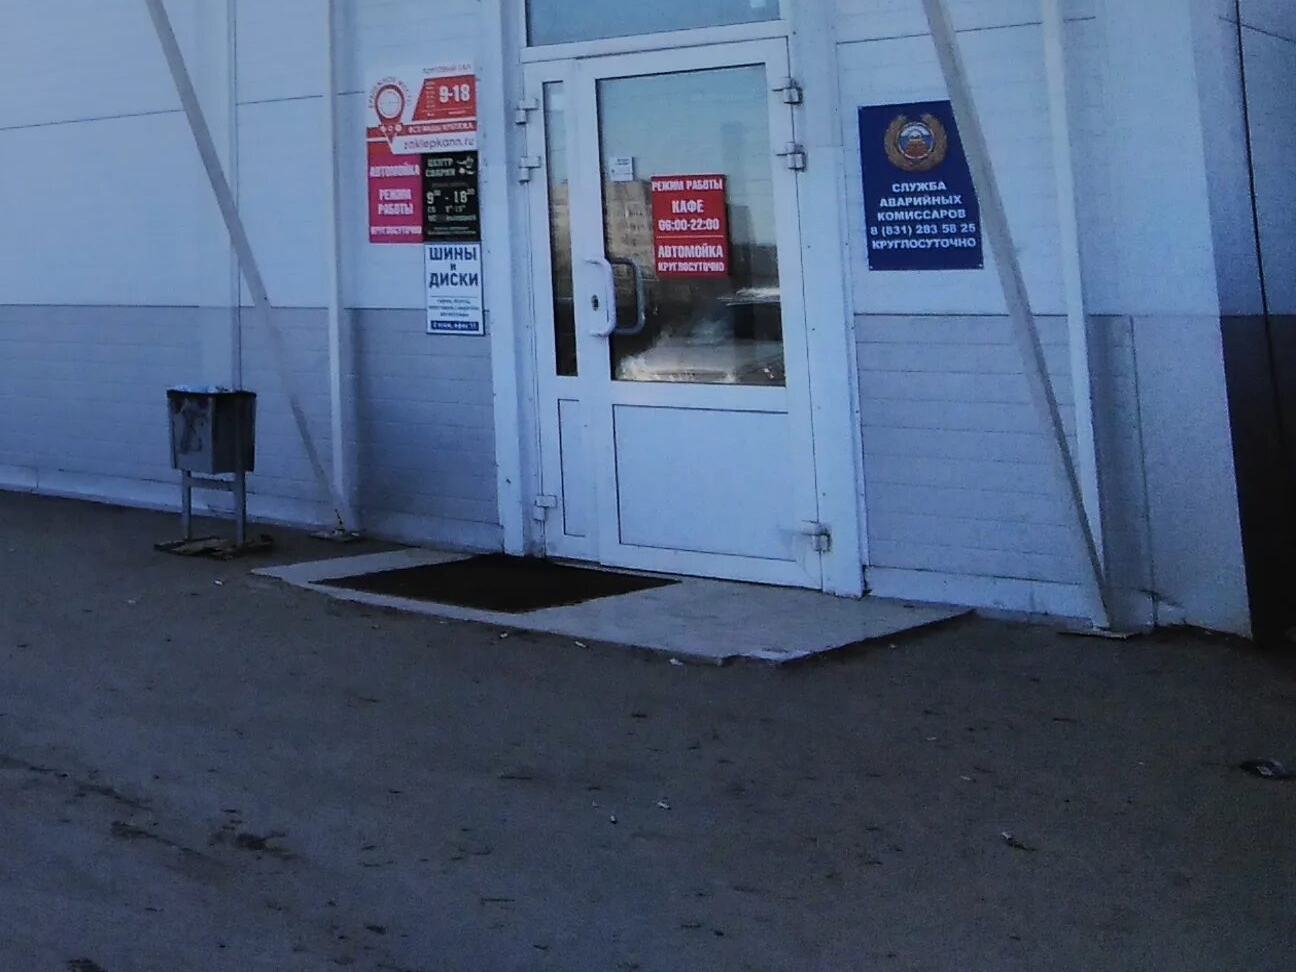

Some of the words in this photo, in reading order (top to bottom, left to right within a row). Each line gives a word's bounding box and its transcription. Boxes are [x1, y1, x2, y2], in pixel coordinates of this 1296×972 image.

[439, 83, 471, 104] 9-18
[651, 180, 684, 191] РЕЖИМ
[686, 178, 722, 190] РАБОТЫ
[892, 181, 947, 192] СЛУЖБА
[671, 199, 704, 213] КАФЕ
[880, 195, 962, 207] АВАРИЙНЫХ
[877, 209, 966, 221] КОМИССАРОВ
[870, 227, 878, 236] 8
[881, 225, 913, 237] (831)
[872, 237, 977, 250] КРУГЛОСУТОЧНО
[429, 247, 477, 260] ШИНЫ
[658, 243, 723, 258] АВТОМОЙКА
[658, 262, 724, 272] КРУГЛОСУТОЧНО
[428, 272, 479, 288] ДИСКИ
